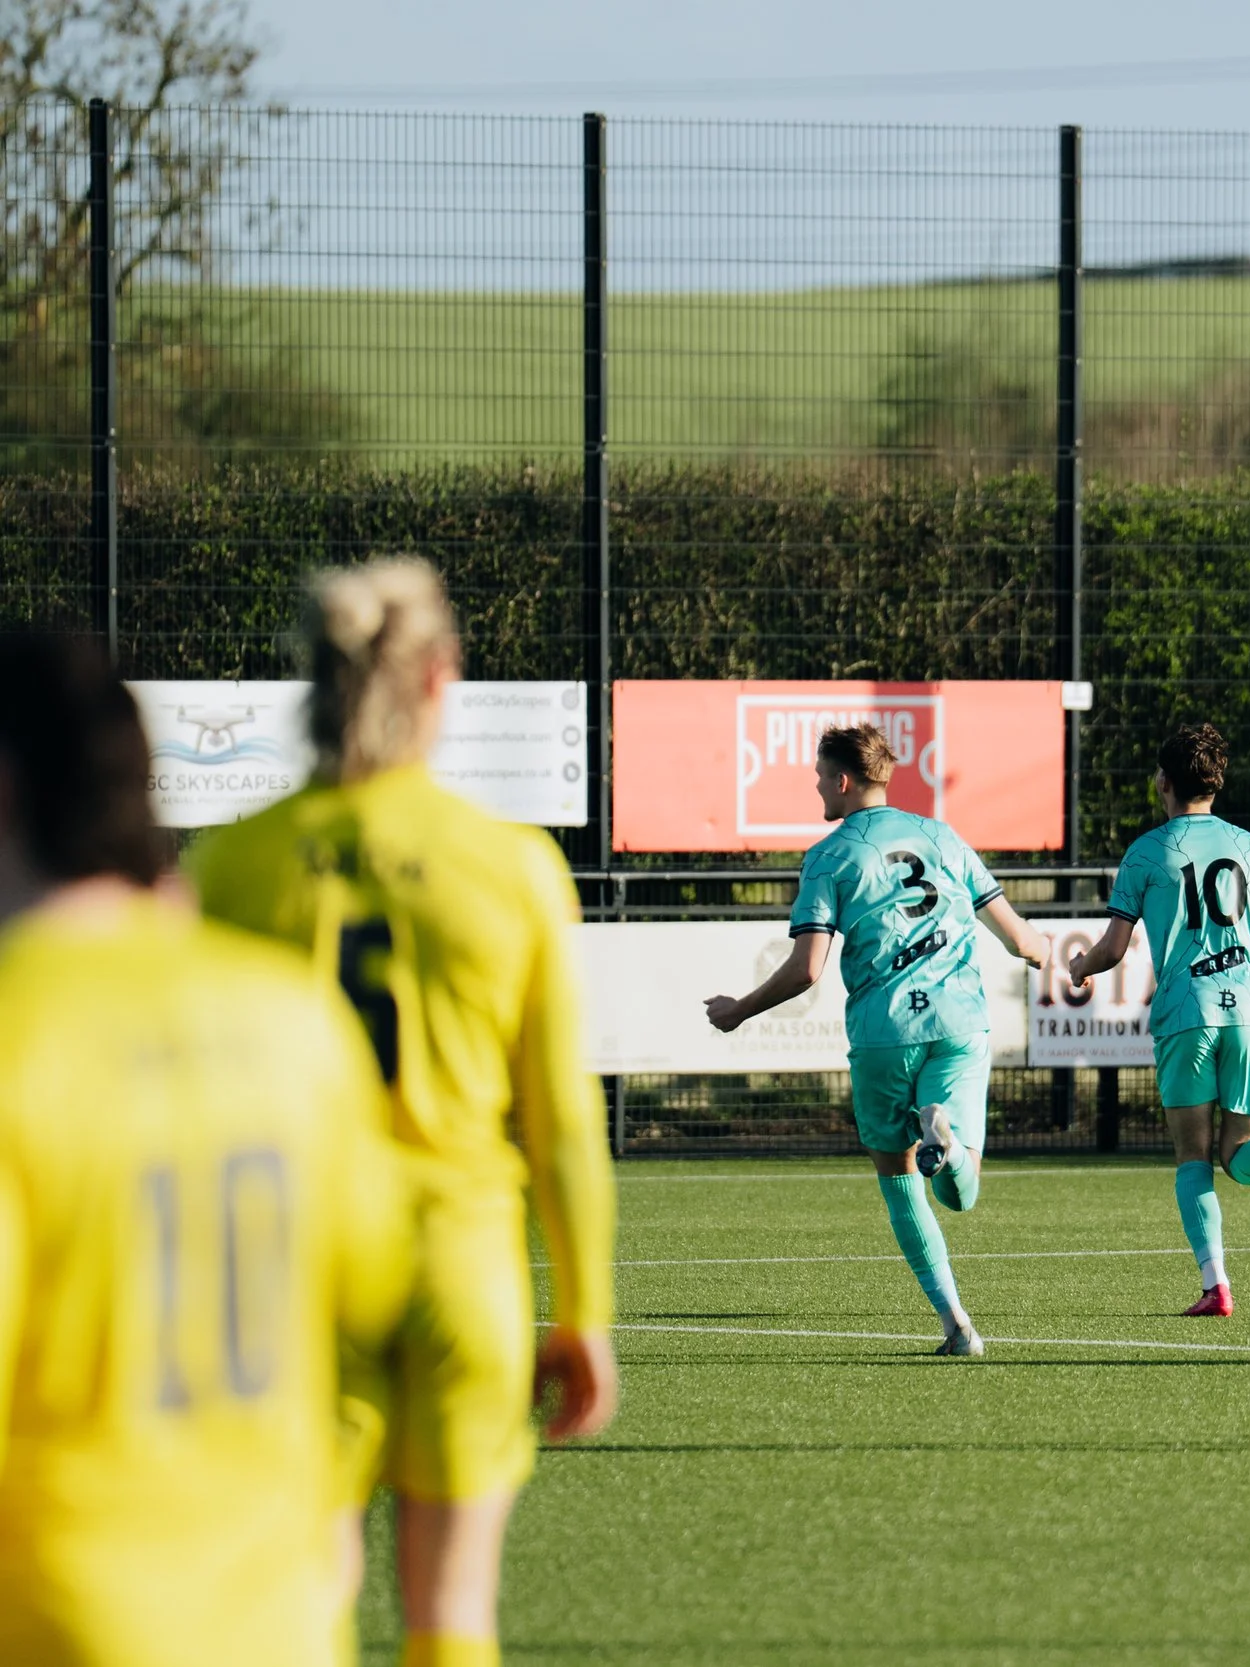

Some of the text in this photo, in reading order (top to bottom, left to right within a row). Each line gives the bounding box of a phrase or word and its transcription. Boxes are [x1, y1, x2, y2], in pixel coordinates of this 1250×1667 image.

[175, 774, 291, 791] SKYSCAPES
[885, 850, 938, 918] 3
[1180, 858, 1248, 930] 10
[758, 1021, 844, 1037] MASONR
[1037, 1019, 1152, 1037] TRADITION
[139, 1144, 289, 1412] 10
